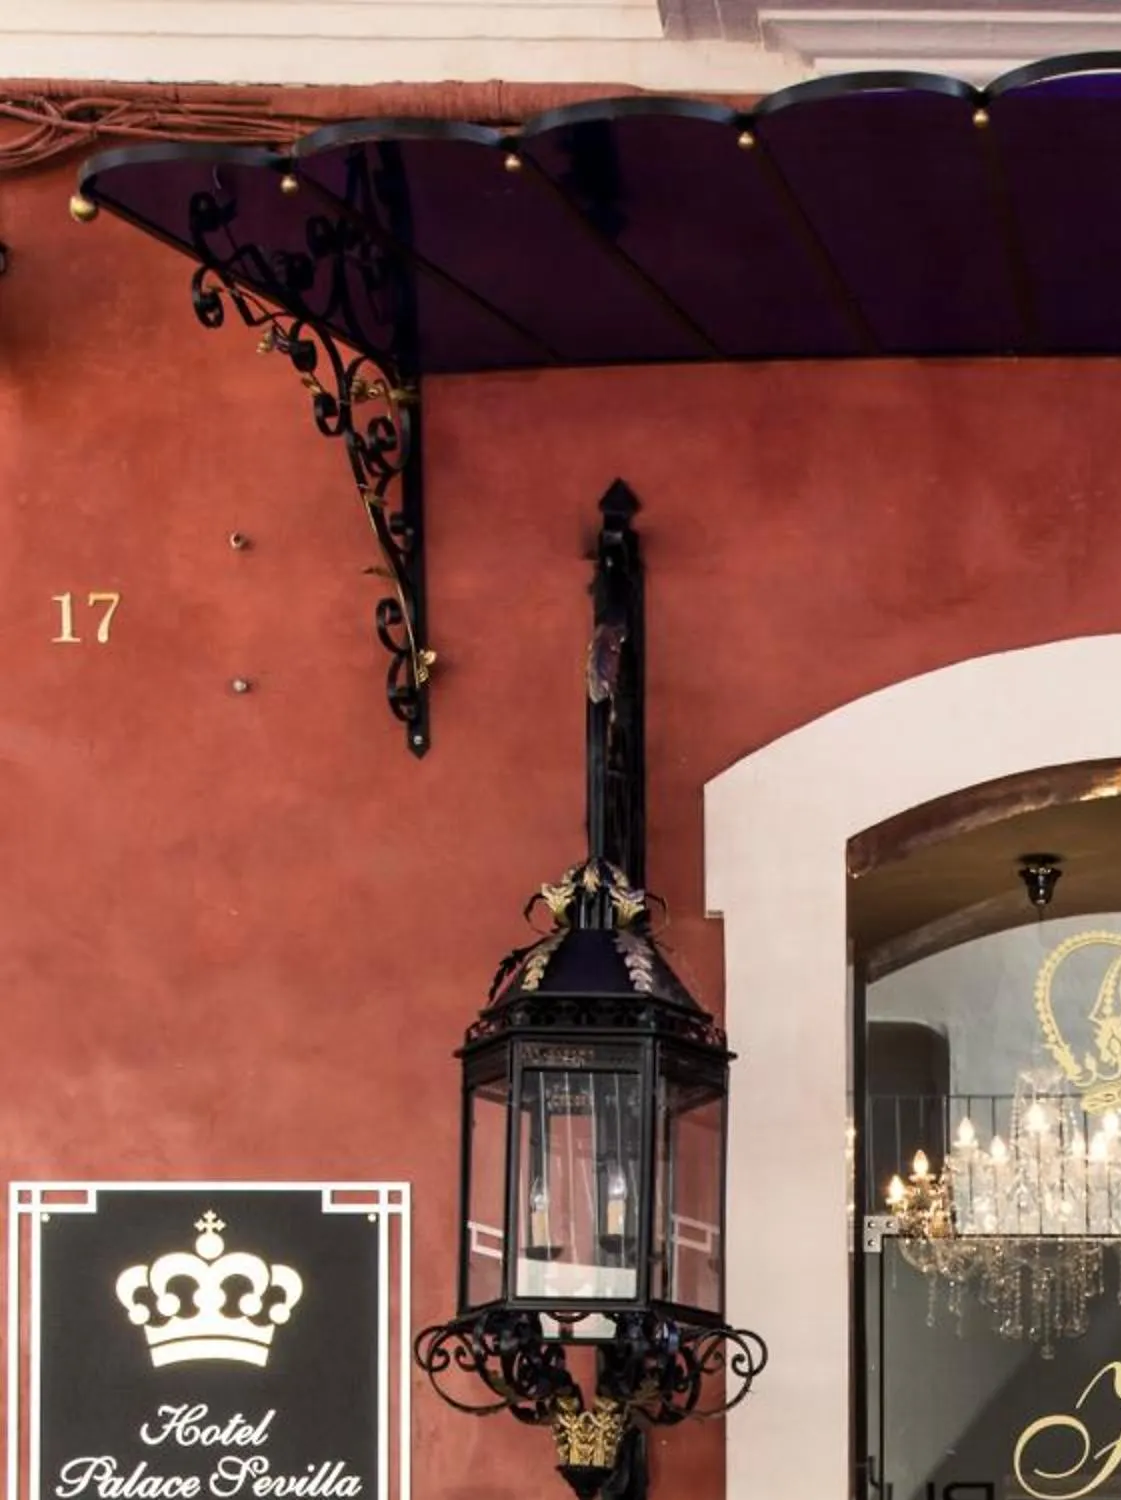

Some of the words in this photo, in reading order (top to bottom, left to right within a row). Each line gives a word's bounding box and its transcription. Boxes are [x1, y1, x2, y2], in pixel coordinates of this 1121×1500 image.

[51, 592, 120, 643] 17
[140, 1403, 277, 1447] Hotel
[55, 1455, 201, 1499] Palace
[209, 1455, 363, 1498] Sevilla
